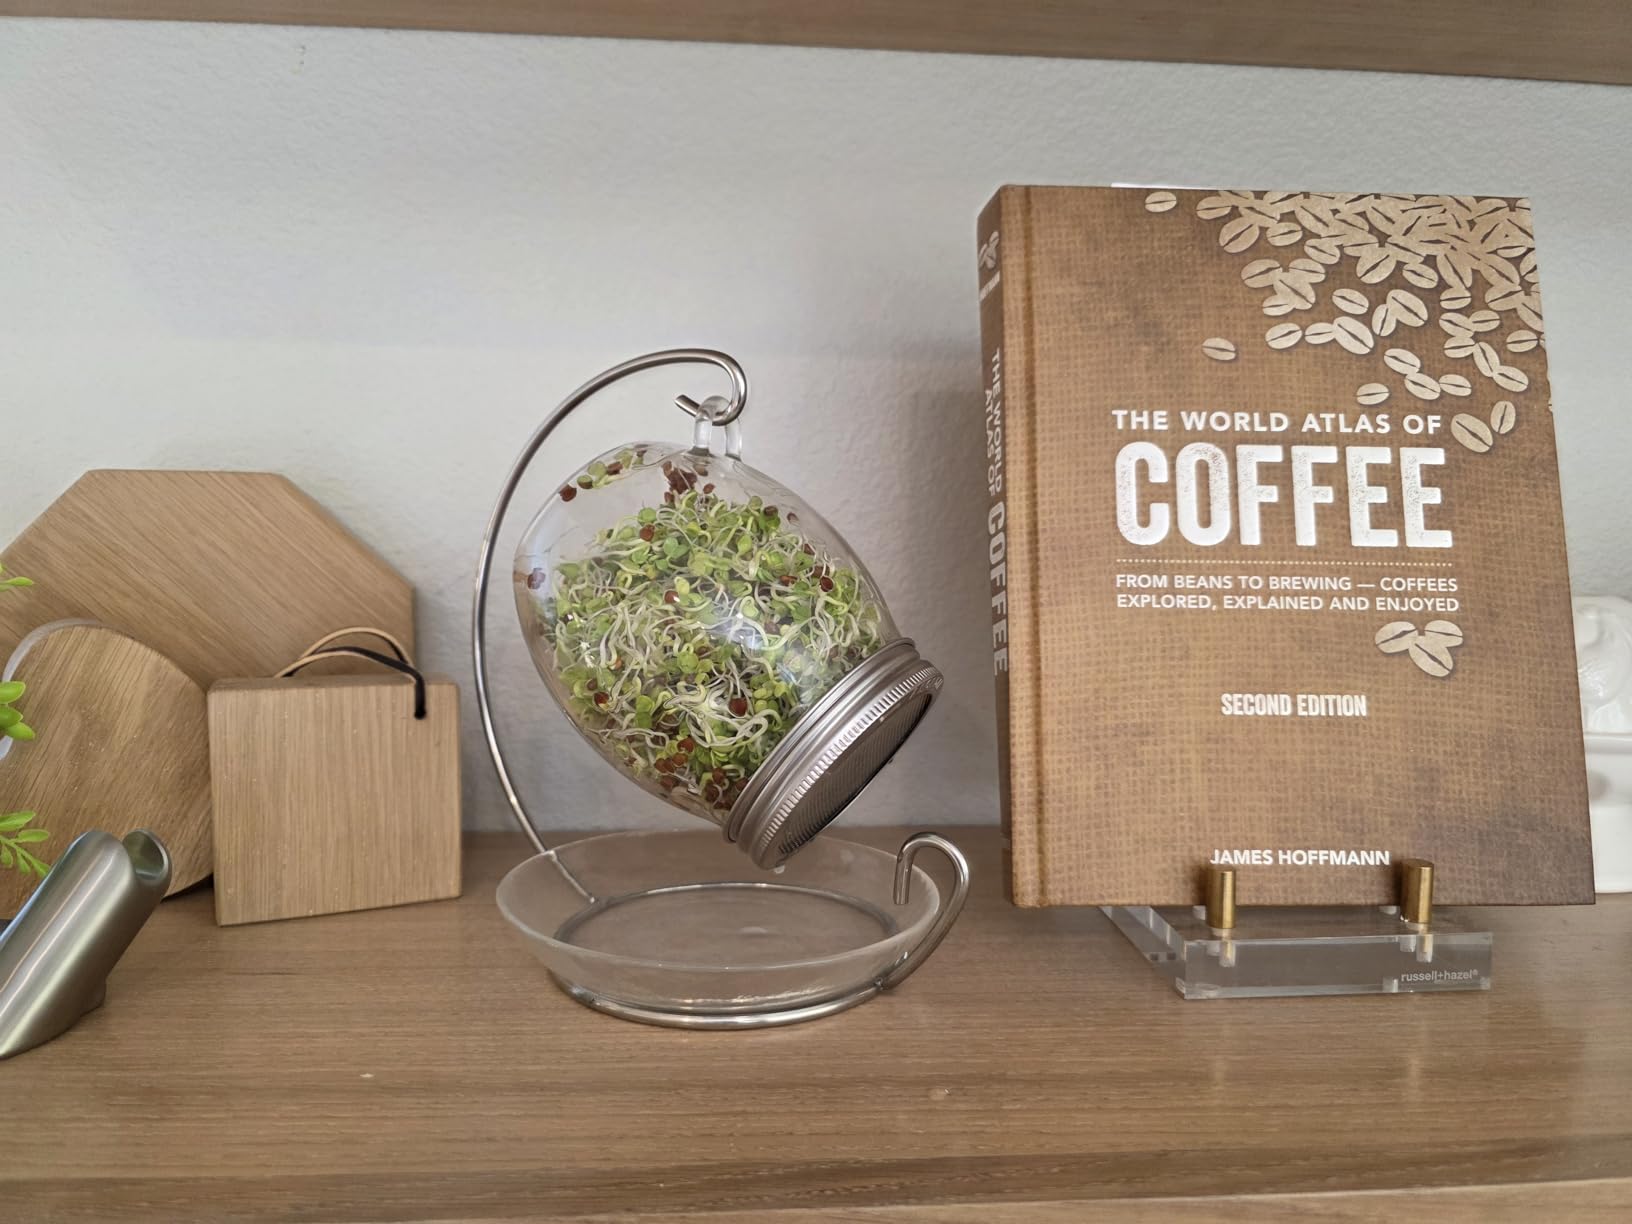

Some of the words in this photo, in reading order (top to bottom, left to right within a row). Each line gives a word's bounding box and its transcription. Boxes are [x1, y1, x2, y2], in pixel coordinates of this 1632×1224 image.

[985, 389, 993, 458] ATLAS
[1112, 410, 1168, 431] THE
[1180, 410, 1289, 433] WORLD
[1302, 412, 1391, 434] ATLAS
[1403, 415, 1441, 435] OF
[993, 402, 1002, 492] WORLD
[988, 465, 995, 496] OF
[1115, 441, 1453, 548] COFFEE
[988, 502, 1008, 676] COFFEE
[1116, 574, 1168, 590] FROM
[1174, 575, 1233, 590] BEANS
[1238, 576, 1263, 590] TO
[1269, 576, 1351, 592] BREWING
[1380, 577, 1458, 593] COFFEES
[1116, 594, 1217, 611] EXPLORED,
[1223, 596, 1322, 611] EXPLAINED
[1329, 596, 1369, 611] AND
[1376, 597, 1460, 612] ENJOYED
[1221, 693, 1292, 716] SECOND
[1297, 694, 1367, 717] EDITION
[1210, 849, 1273, 865] JAMES
[1278, 850, 1391, 866] HOFFMANN
